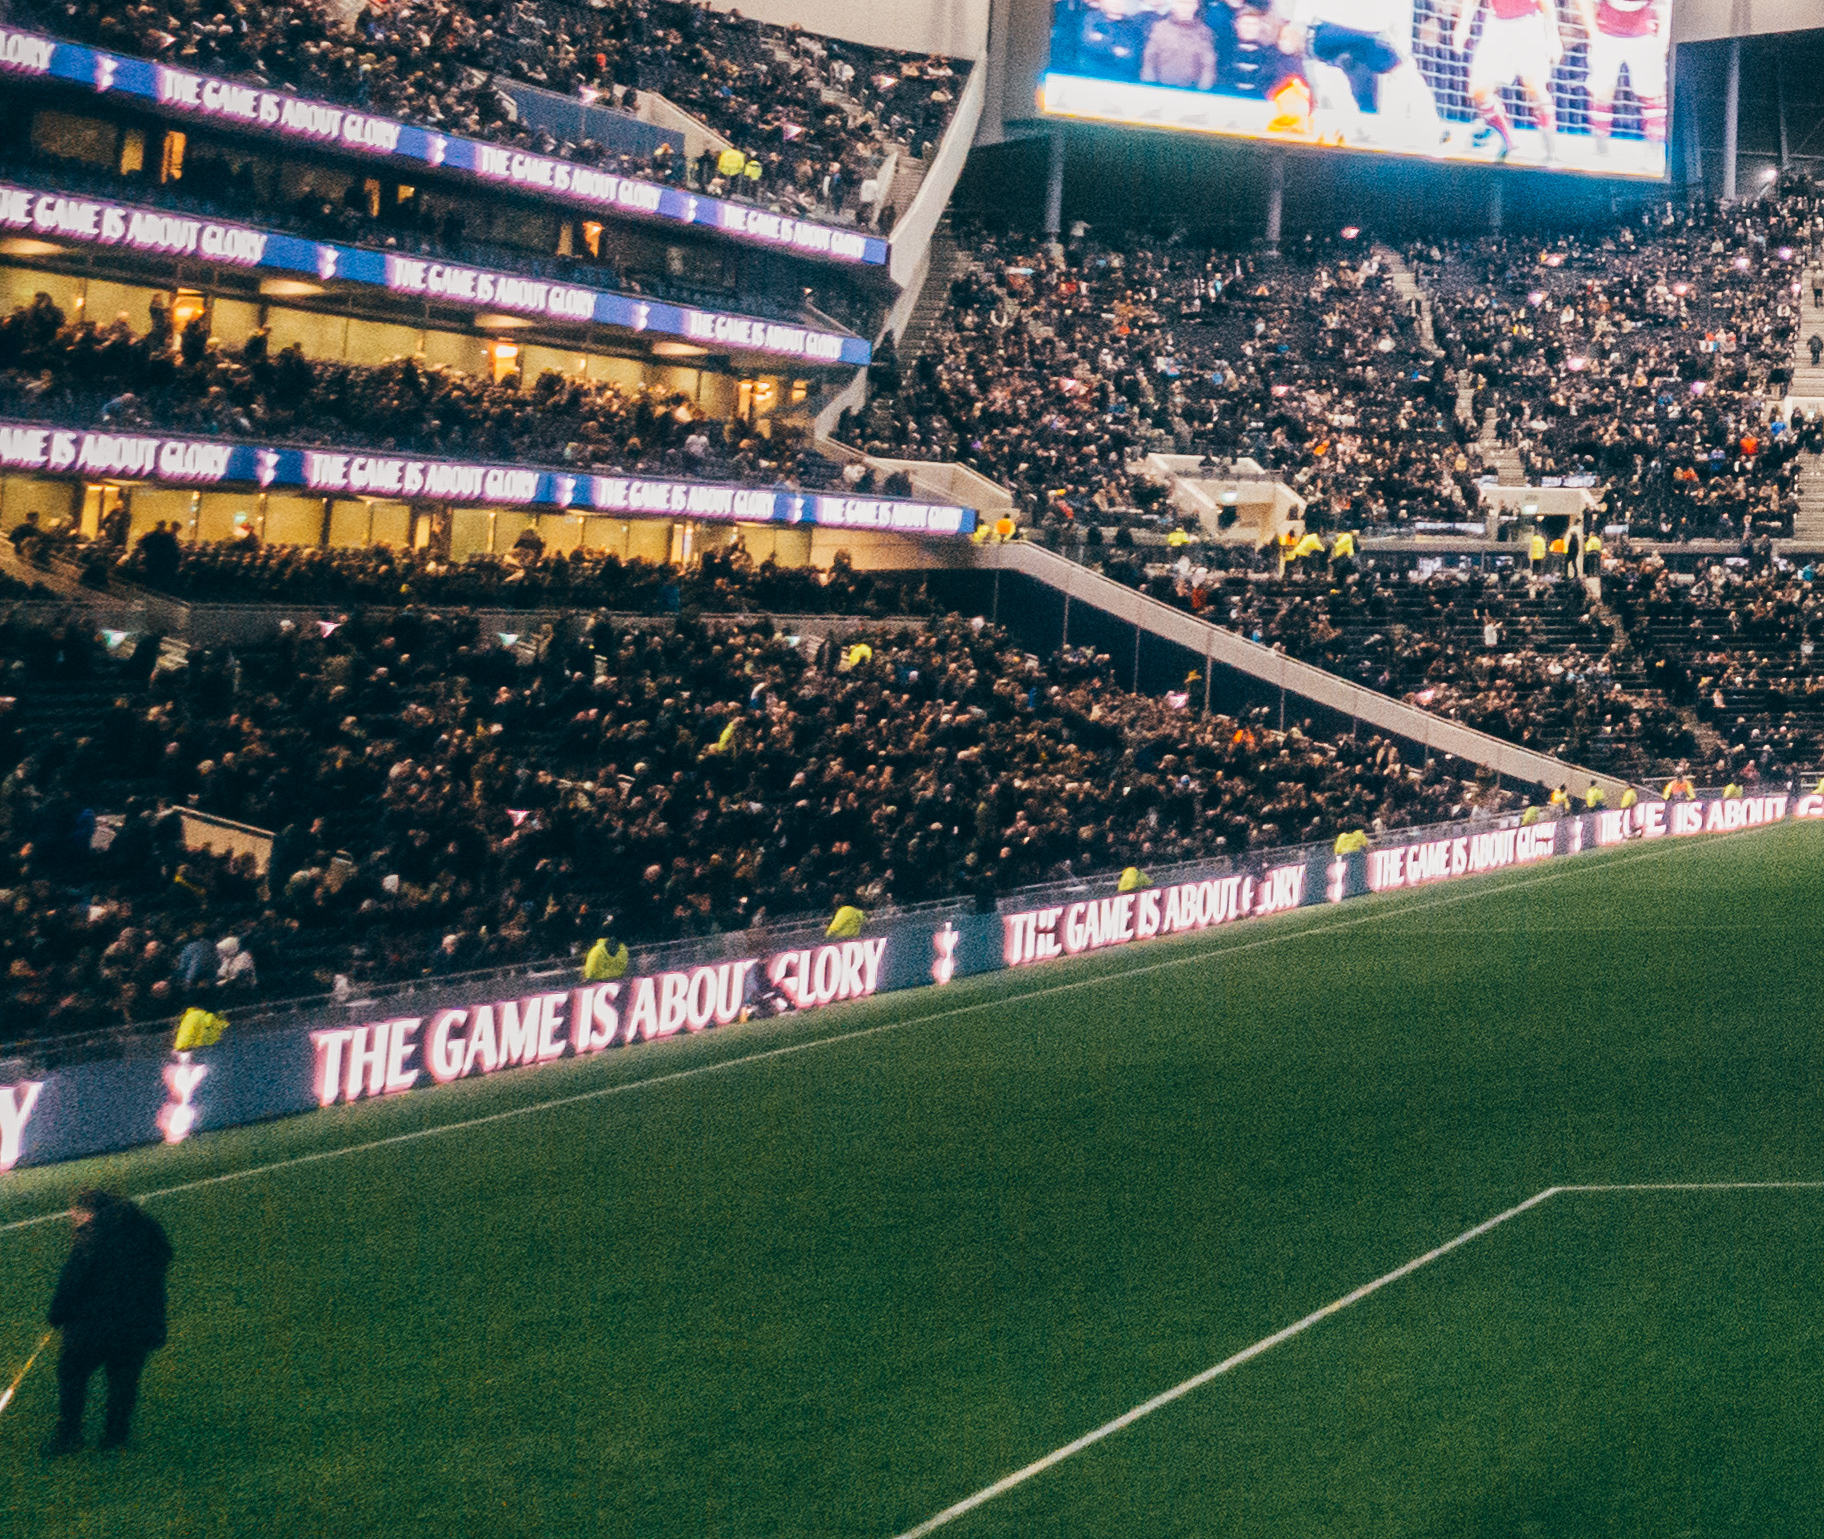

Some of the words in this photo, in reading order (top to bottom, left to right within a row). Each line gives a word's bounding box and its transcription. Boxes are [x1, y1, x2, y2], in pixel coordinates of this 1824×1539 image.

[164, 69, 201, 103] THE
[203, 81, 257, 118] GAME
[260, 94, 279, 123] IS
[281, 99, 343, 139] ABOUT
[343, 114, 400, 150] GLORY
[35, 197, 101, 235] GAME
[103, 207, 126, 239] IS
[127, 213, 201, 250] ABOUT
[202, 225, 268, 262] GLORY
[395, 259, 427, 288] THE
[428, 265, 477, 298] GAME
[477, 273, 494, 301] IS
[0, 428, 49, 461] AME
[51, 432, 76, 463] IS
[78, 435, 159, 470] ABOUT
[160, 442, 233, 475] GLORY
[312, 454, 349, 484] THE
[350, 458, 402, 489] GAME
[404, 463, 424, 492] IS
[424, 465, 485, 495] ABOUT
[485, 469, 539, 499] GLORY
[1707, 796, 1788, 831] ABOUT
[1375, 848, 1405, 888] THE
[1406, 840, 1450, 882] GAME
[1452, 837, 1469, 874] IS
[1468, 828, 1517, 871] ABOUT
[1066, 893, 1135, 954] GAME
[1138, 889, 1162, 936] IS
[1164, 875, 1241, 933] ABOUT
[317, 1017, 421, 1106] THE
[430, 992, 568, 1084] GAME
[576, 982, 621, 1054] IS
